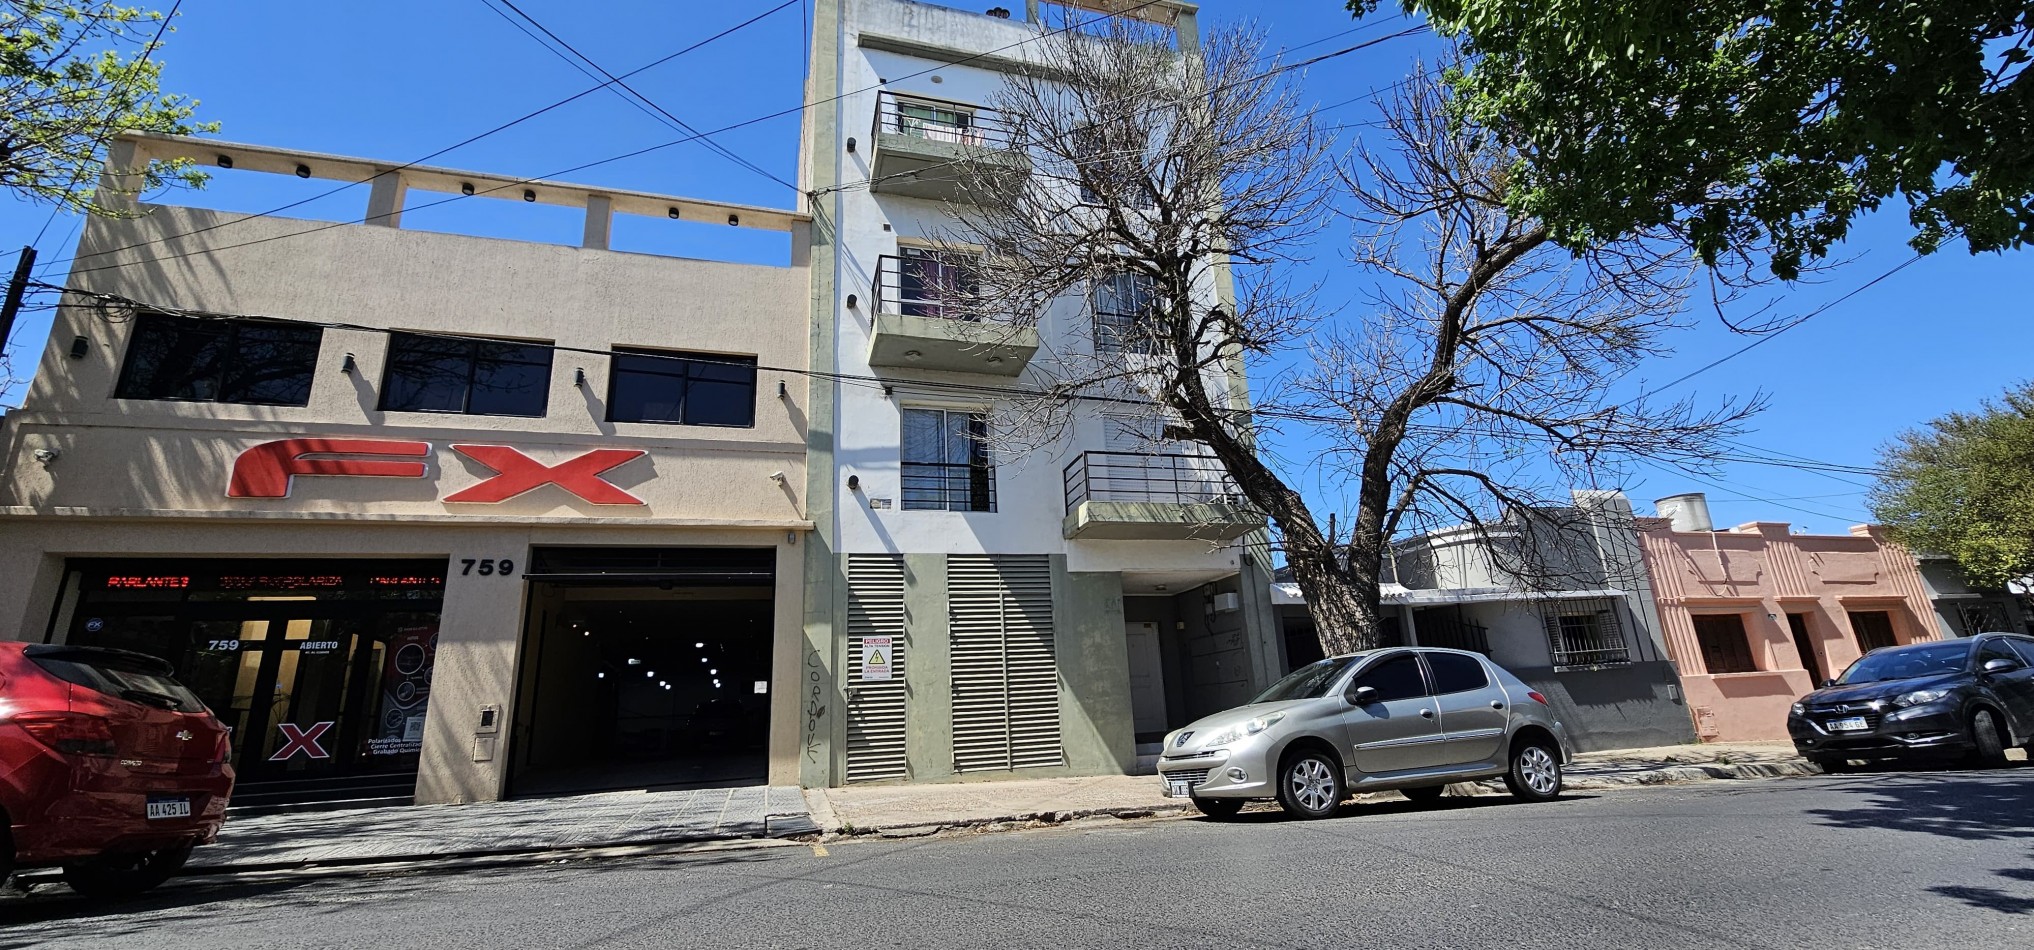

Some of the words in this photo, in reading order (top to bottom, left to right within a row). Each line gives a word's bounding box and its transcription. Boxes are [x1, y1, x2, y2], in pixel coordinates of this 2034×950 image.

[225, 438, 648, 506] FX
[460, 559, 514, 576] 759
[208, 640, 239, 651] 759
[299, 641, 338, 650] ABIERTO
[150, 804, 160, 817] AA
[162, 803, 177, 816] 425
[179, 803, 189, 815] IL
